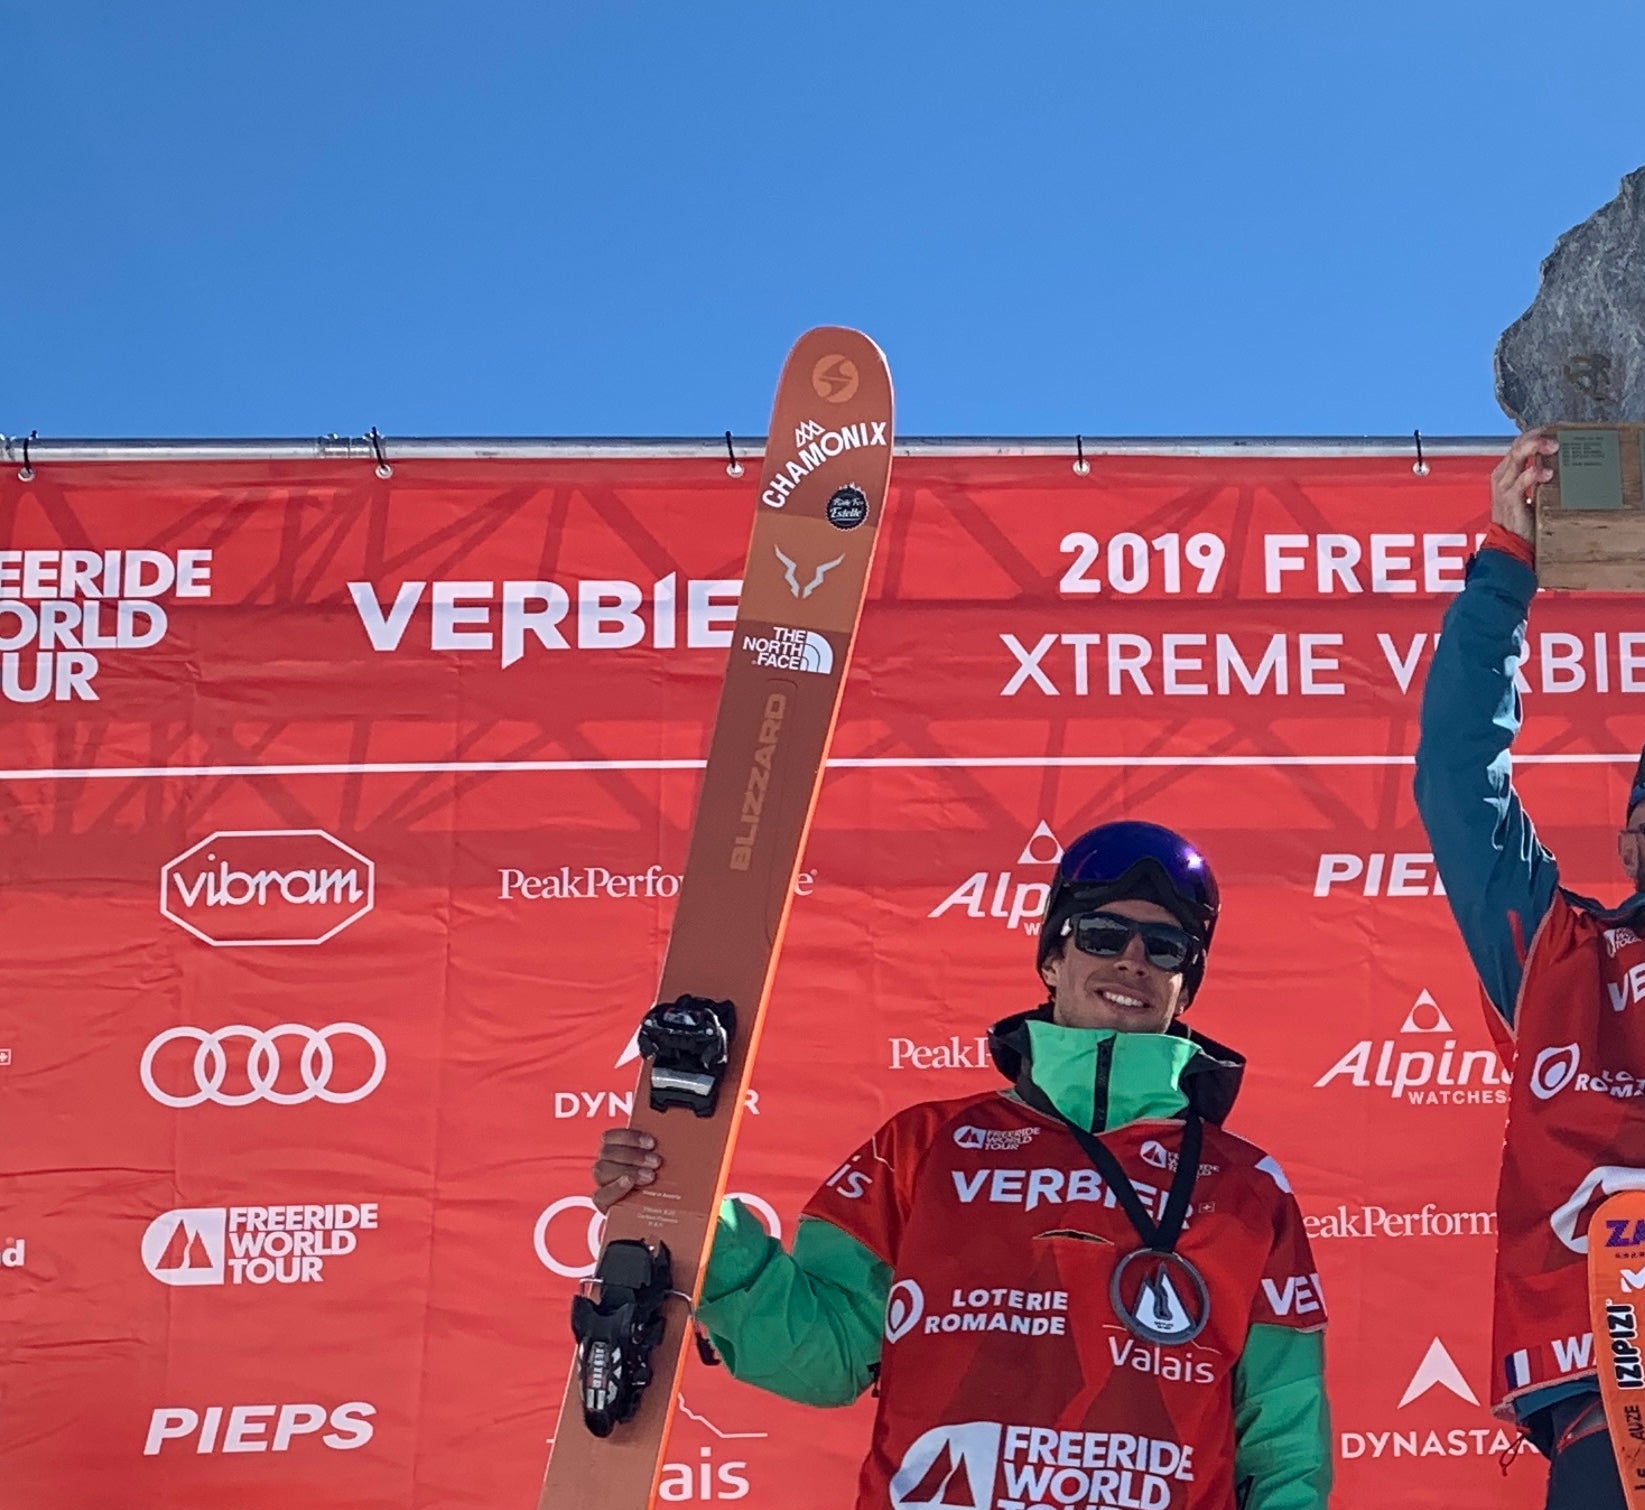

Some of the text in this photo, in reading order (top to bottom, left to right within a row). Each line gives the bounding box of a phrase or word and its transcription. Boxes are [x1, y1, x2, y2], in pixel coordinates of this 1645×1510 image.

[762, 420, 888, 509] CHAMONIX
[0, 549, 213, 599] EERIDE
[1059, 530, 1488, 597] 2019 FREE
[0, 599, 168, 651] ORLD
[345, 567, 746, 672] VERBIE
[773, 626, 807, 643] THE
[743, 638, 804, 656] NORTH
[757, 652, 801, 669] FACE
[999, 633, 1345, 696] XTREME
[1, 651, 100, 703] UR
[731, 693, 786, 872] BLIZZARD
[173, 853, 364, 908] vibram
[928, 871, 1050, 928] Alp
[1314, 852, 1450, 898] PIE
[1313, 1038, 1515, 1096] Alpin
[554, 1090, 761, 1120] DYNR
[1408, 1088, 1509, 1106] WATCHES
[228, 1203, 379, 1233] FREERIDE
[1304, 1204, 1498, 1242] eakPerform
[228, 1229, 357, 1259] WORLD
[227, 1256, 324, 1284] TOUR
[924, 1312, 1066, 1336] ROMANDE
[952, 1288, 1069, 1311] LOTERIE
[1108, 1333, 1216, 1384] Valais
[1606, 1303, 1645, 1391] IZIPIZI
[143, 1401, 377, 1456] PIEPS
[658, 1446, 750, 1502] ais
[1002, 1425, 1194, 1484] FREERIDE
